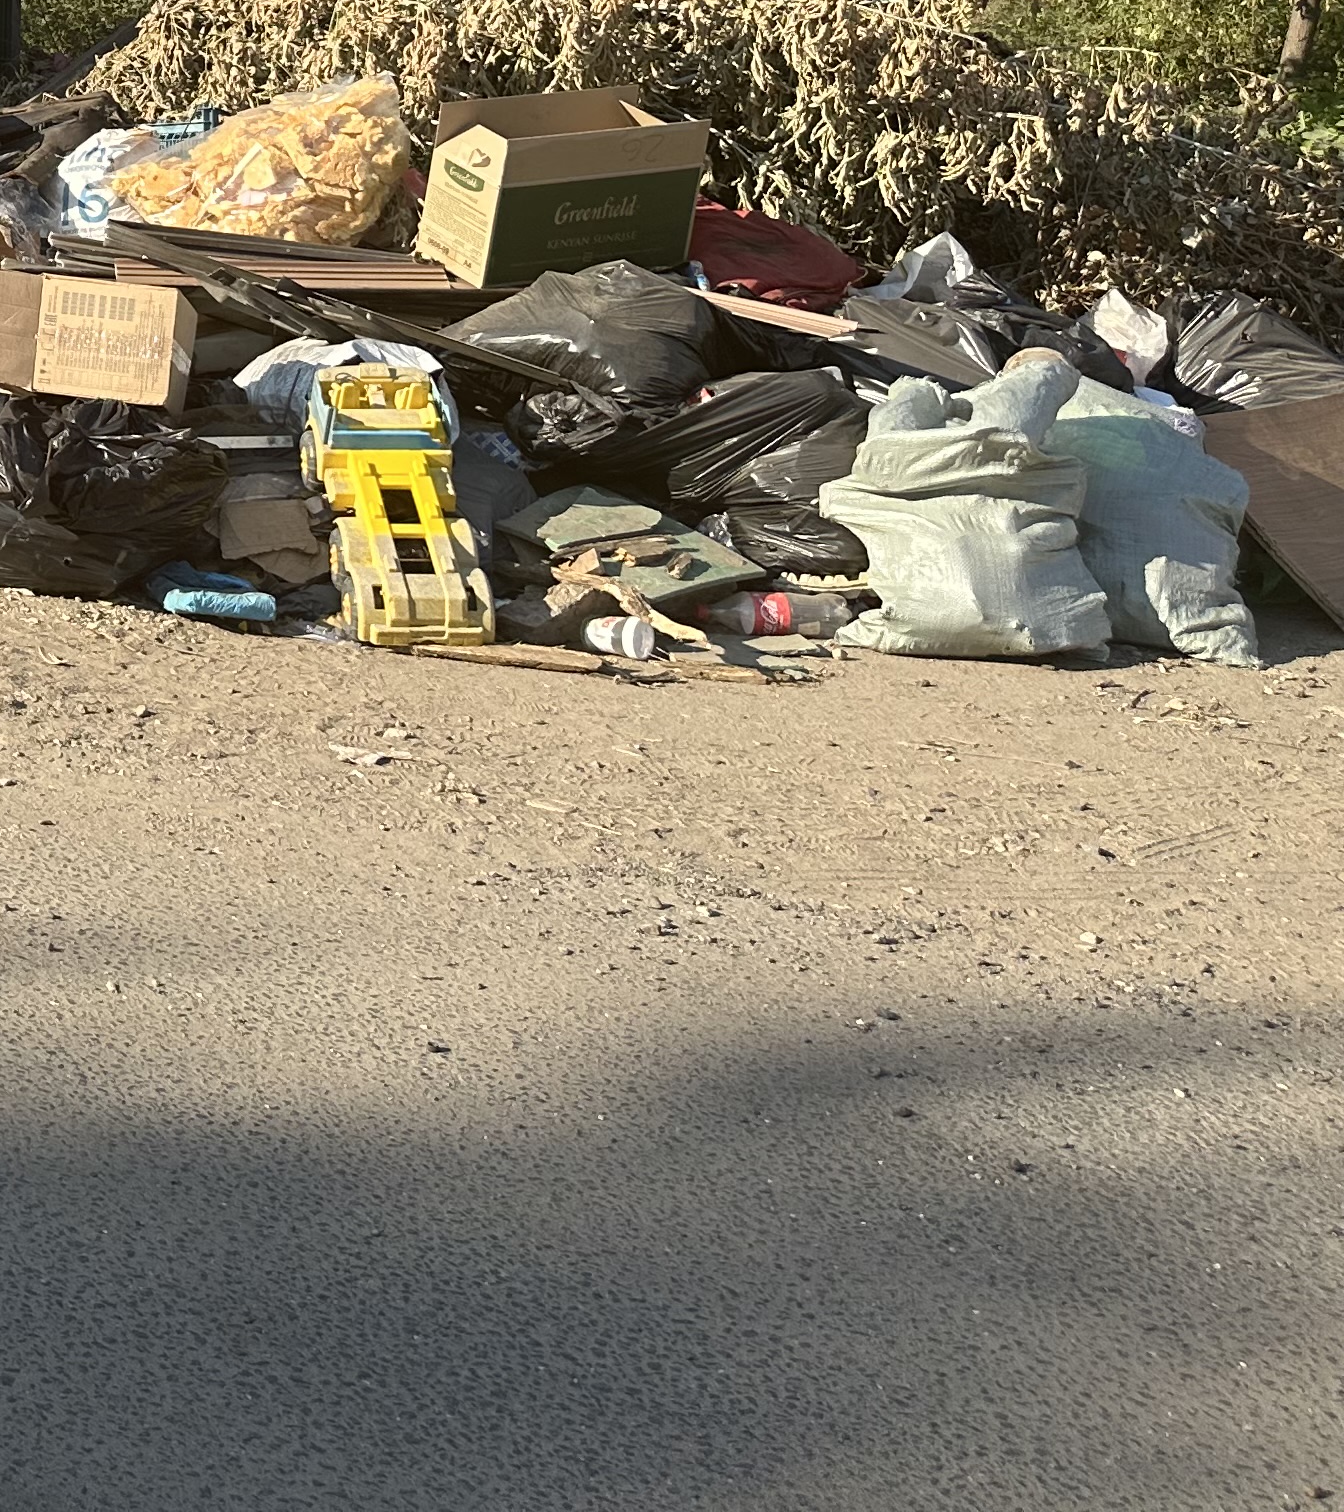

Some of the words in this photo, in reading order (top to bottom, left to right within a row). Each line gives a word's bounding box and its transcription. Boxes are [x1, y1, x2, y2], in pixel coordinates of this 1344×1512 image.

[554, 194, 638, 225] Greenfield
[546, 236, 591, 250] KENYAN
[593, 230, 638, 245] SUNRISE
